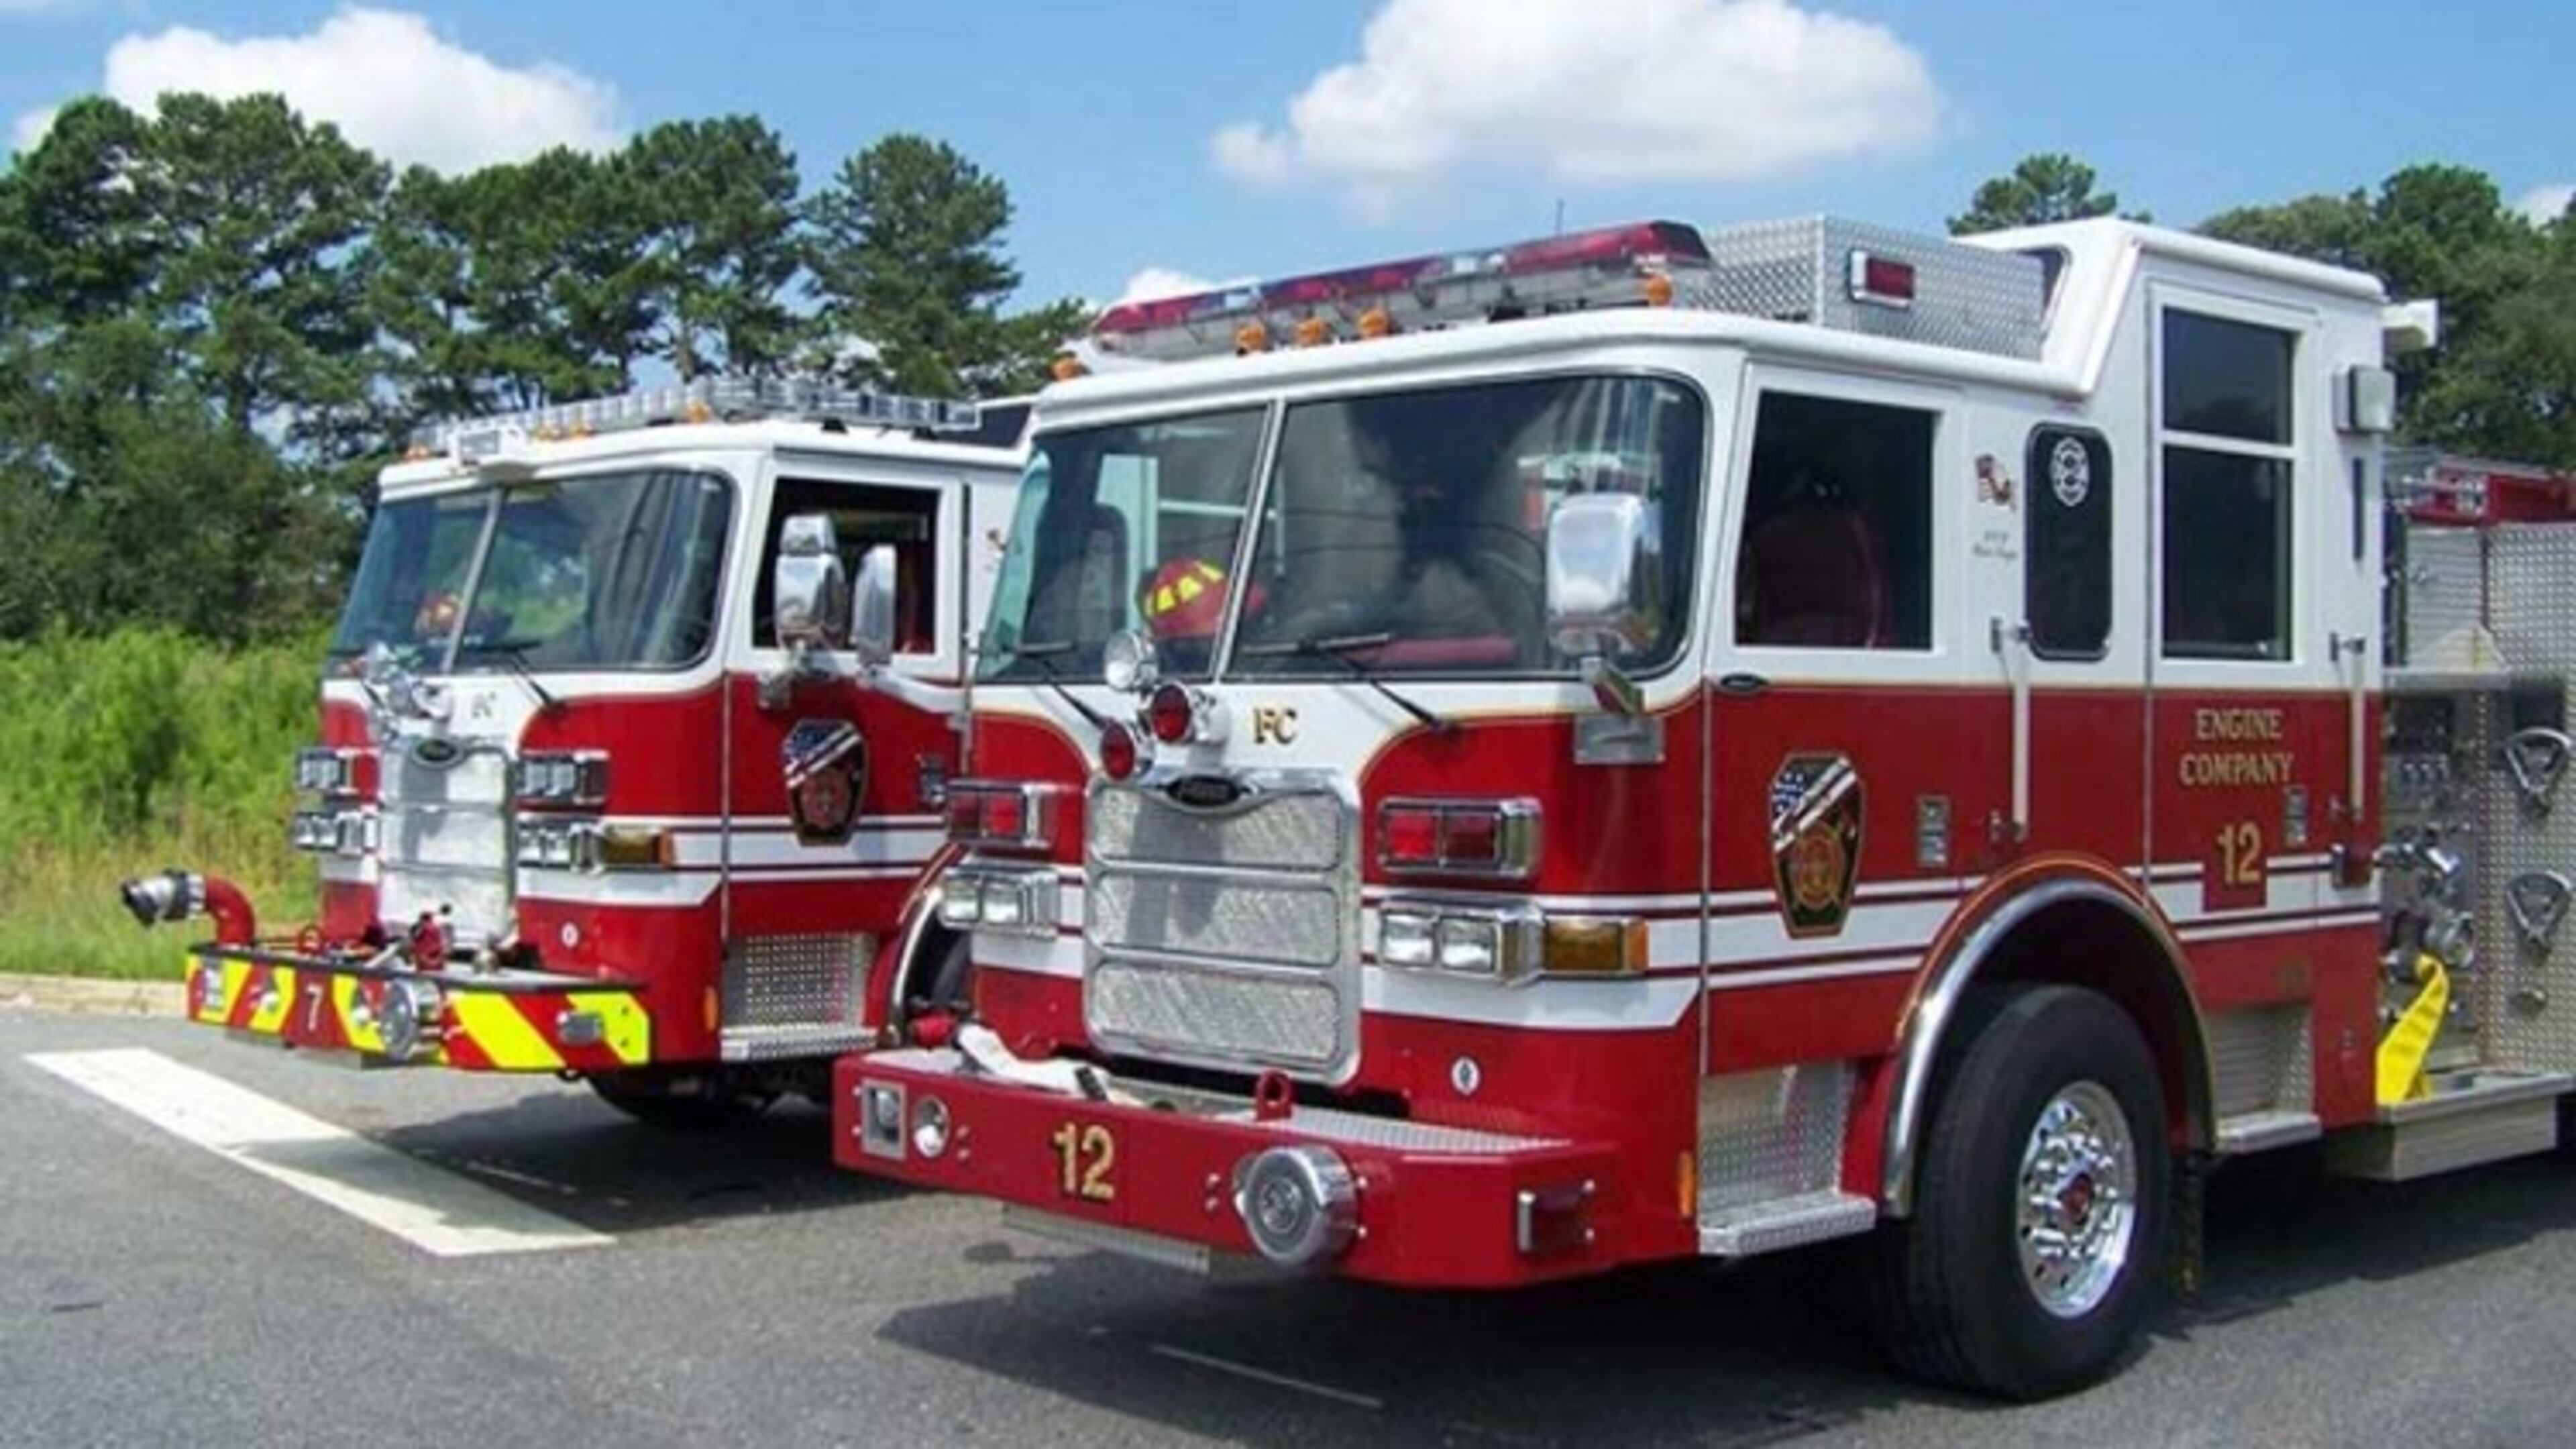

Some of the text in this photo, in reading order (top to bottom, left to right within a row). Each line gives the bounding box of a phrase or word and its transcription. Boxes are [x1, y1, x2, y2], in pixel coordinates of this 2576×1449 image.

[2196, 709, 2283, 740] ENGINE
[2179, 752, 2294, 786] COMPANY
[2216, 822, 2261, 884] 12
[305, 984, 325, 1031] 7
[1054, 1123, 1115, 1199] 12
